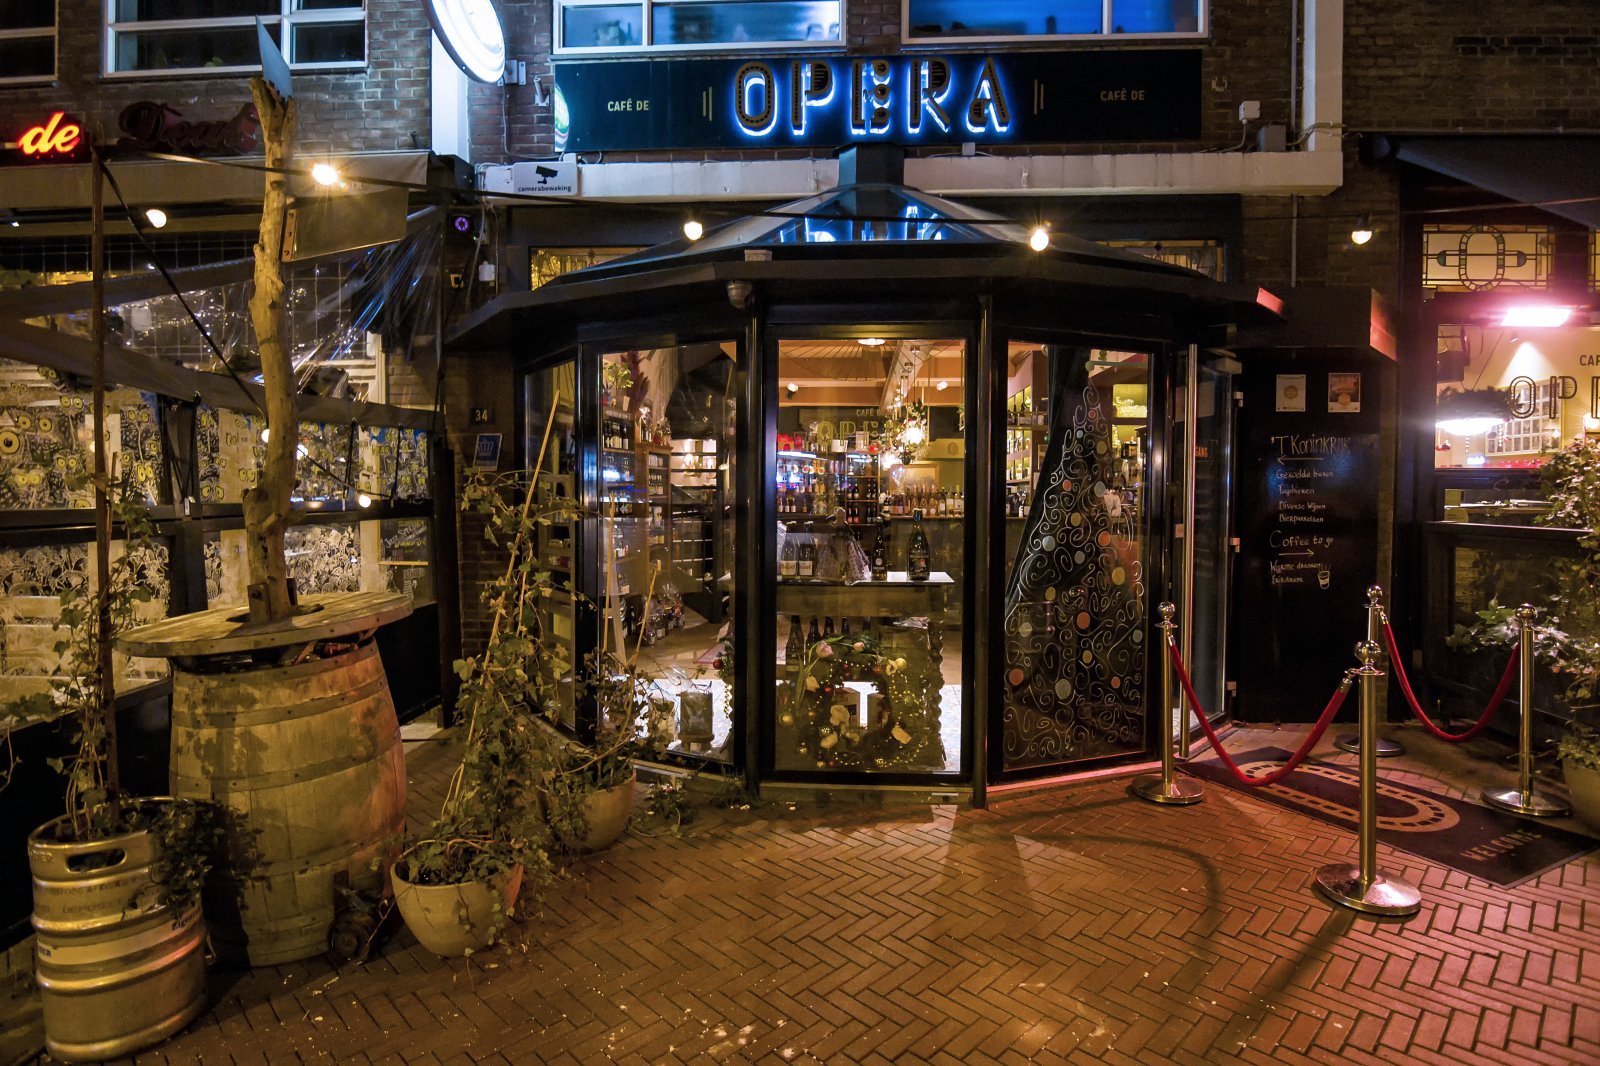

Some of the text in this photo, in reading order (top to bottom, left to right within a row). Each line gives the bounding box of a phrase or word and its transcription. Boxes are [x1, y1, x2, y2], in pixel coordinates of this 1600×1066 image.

[733, 56, 1012, 136] OPERA
[1100, 87, 1145, 101] CAFÉ DE
[607, 97, 650, 112] CAFÉ DE
[18, 111, 82, 154] de
[475, 409, 488, 422] 34
[1270, 529, 1310, 548] Coffee
[1313, 535, 1323, 545] to
